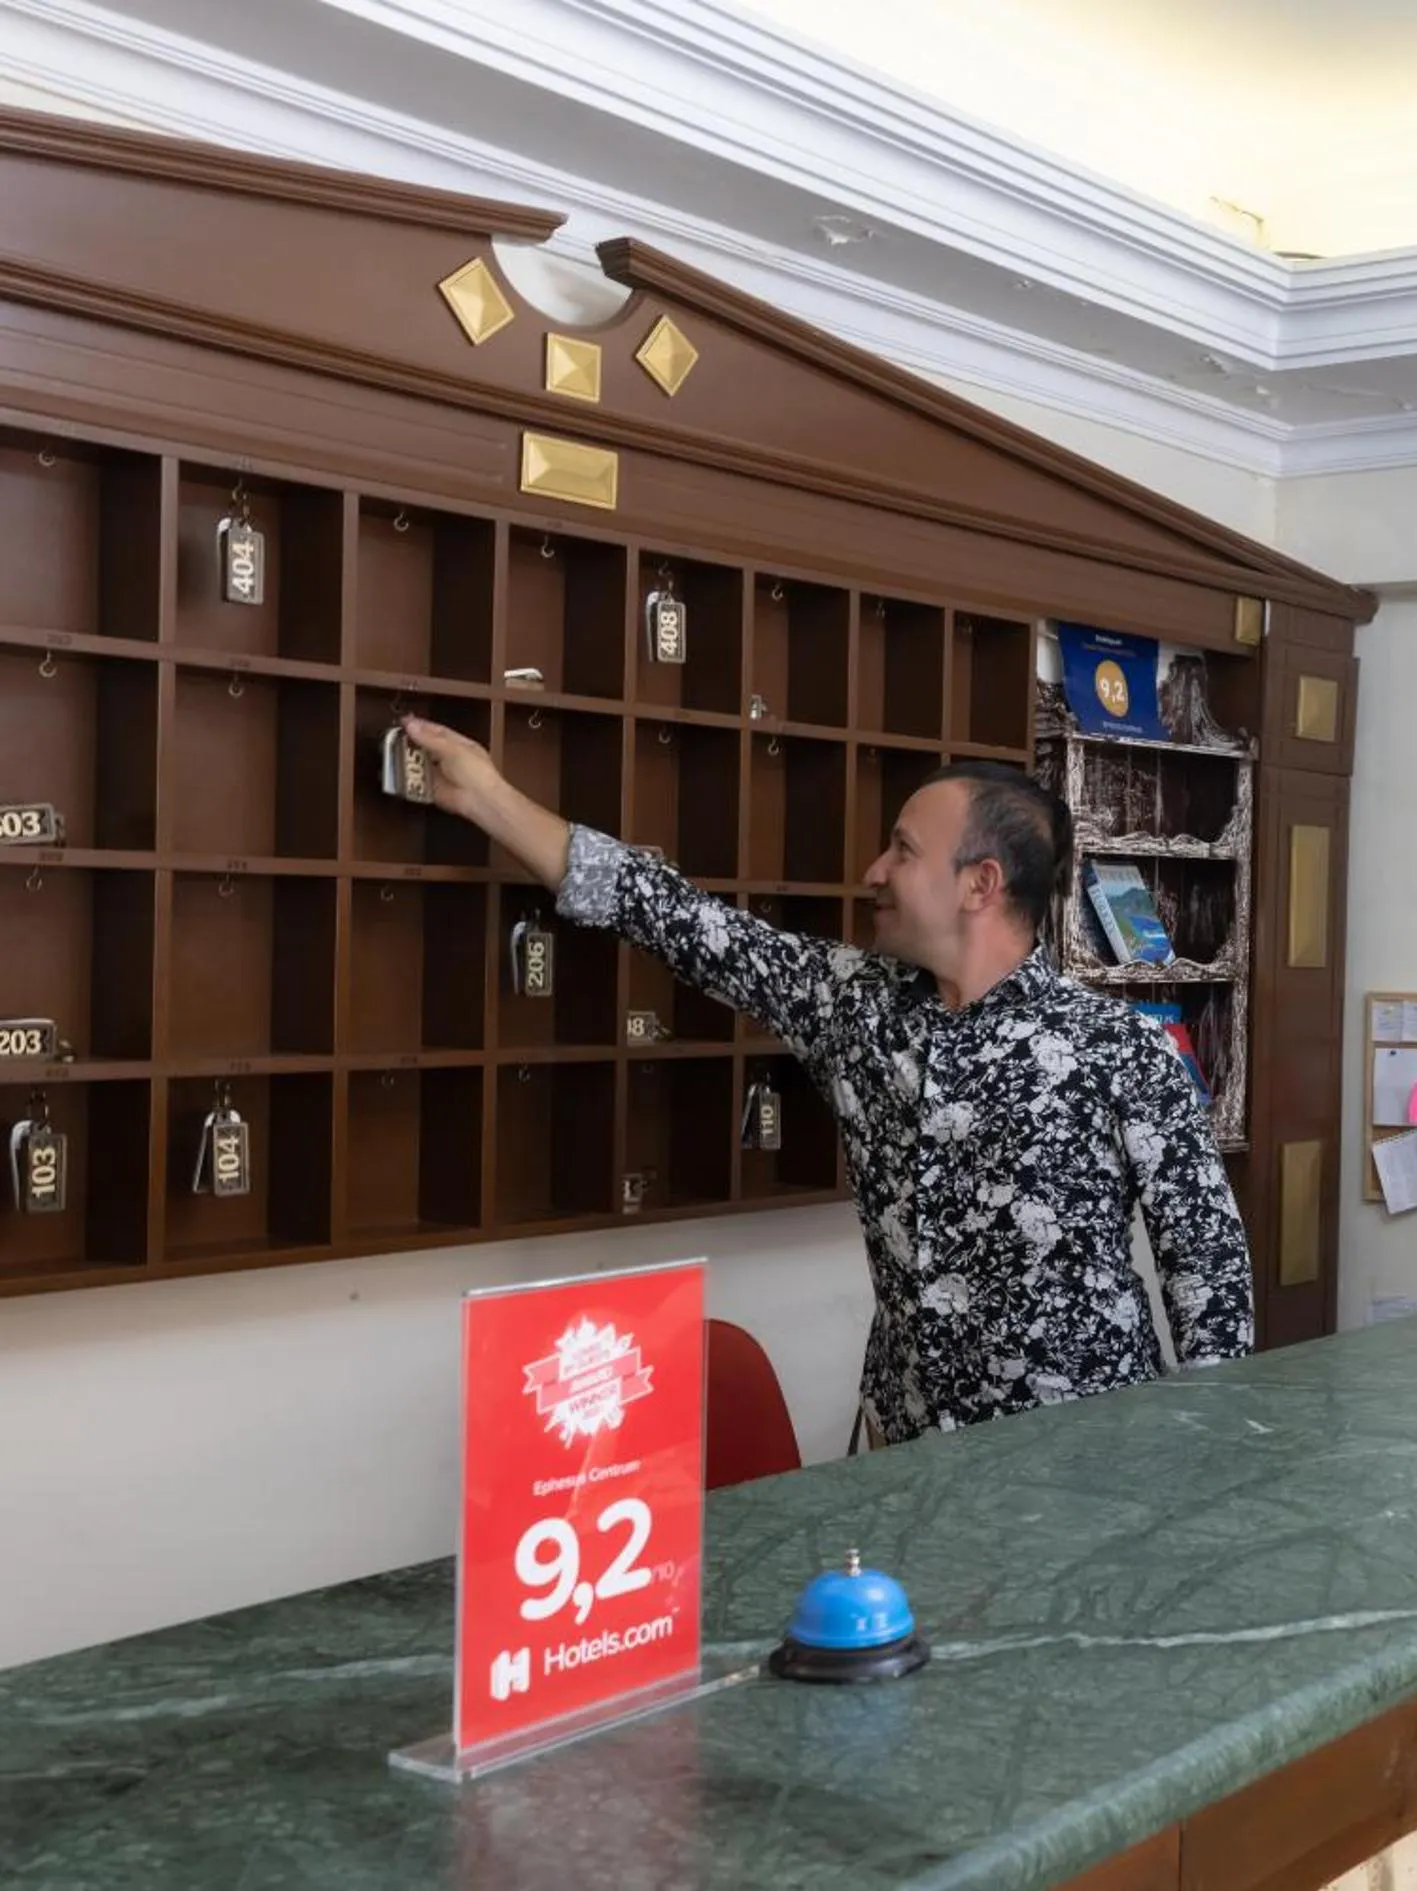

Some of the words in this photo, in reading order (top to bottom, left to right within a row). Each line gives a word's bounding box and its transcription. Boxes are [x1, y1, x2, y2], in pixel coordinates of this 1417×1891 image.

[231, 541, 255, 595] 404
[660, 610, 678, 656] 408
[405, 747, 426, 796] 305
[0, 811, 41, 838] 03
[527, 941, 545, 988] 206
[0, 1029, 42, 1055] 203
[627, 1017, 645, 1037] 8
[760, 1105, 774, 1137] 110
[32, 1147, 56, 1199] 103
[218, 1136, 241, 1185] 104
[533, 1472, 587, 1497] Ephesus
[514, 1497, 652, 1625] 9,2
[543, 1614, 673, 1676] Hotels.com
